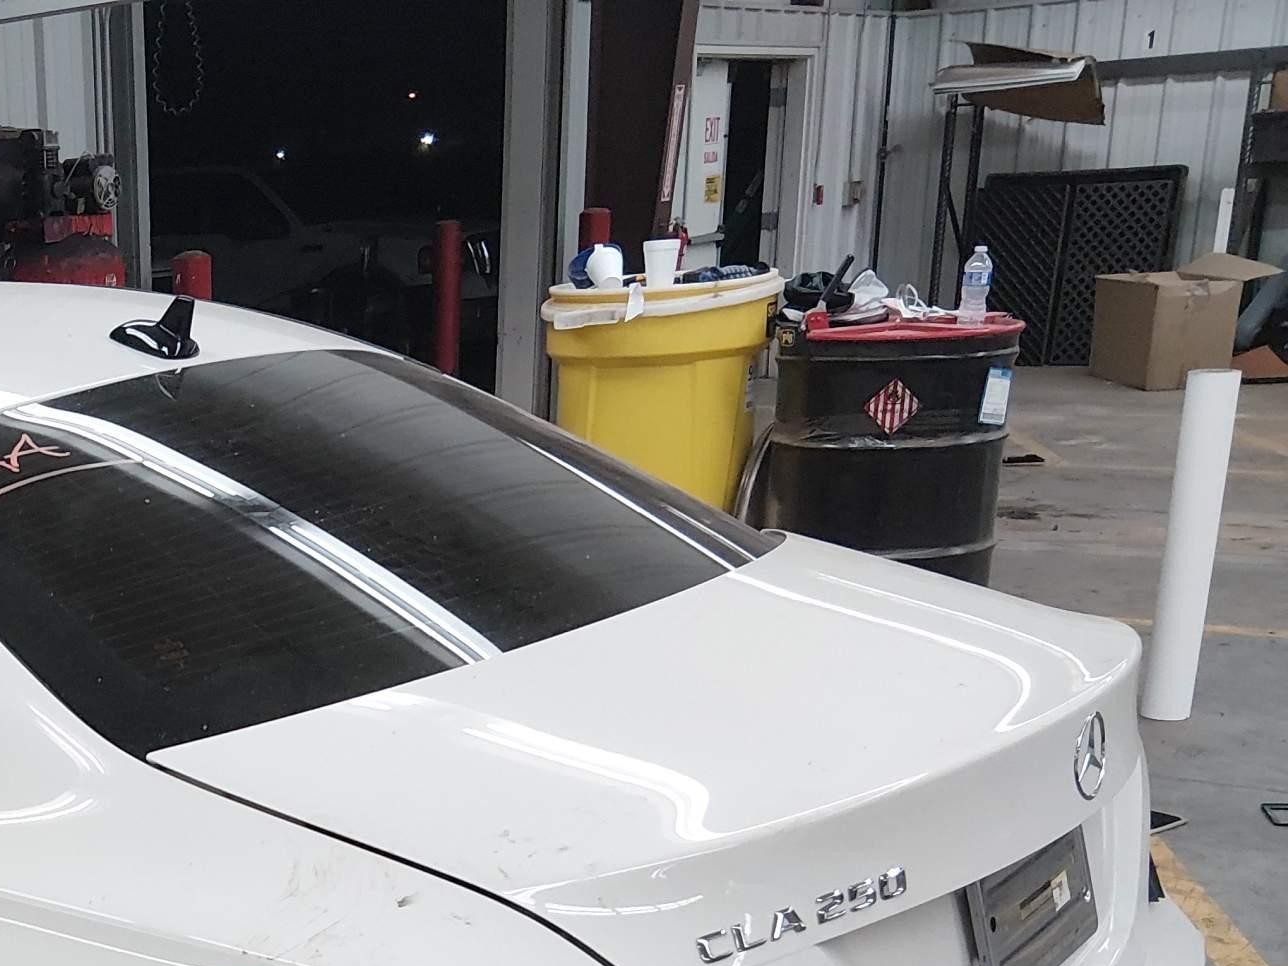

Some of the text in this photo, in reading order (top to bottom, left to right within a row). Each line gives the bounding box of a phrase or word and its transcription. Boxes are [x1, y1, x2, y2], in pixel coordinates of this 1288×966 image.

[1148, 30, 1155, 49] 1
[705, 117, 721, 143] EXIT
[696, 864, 907, 964] CLA 250
